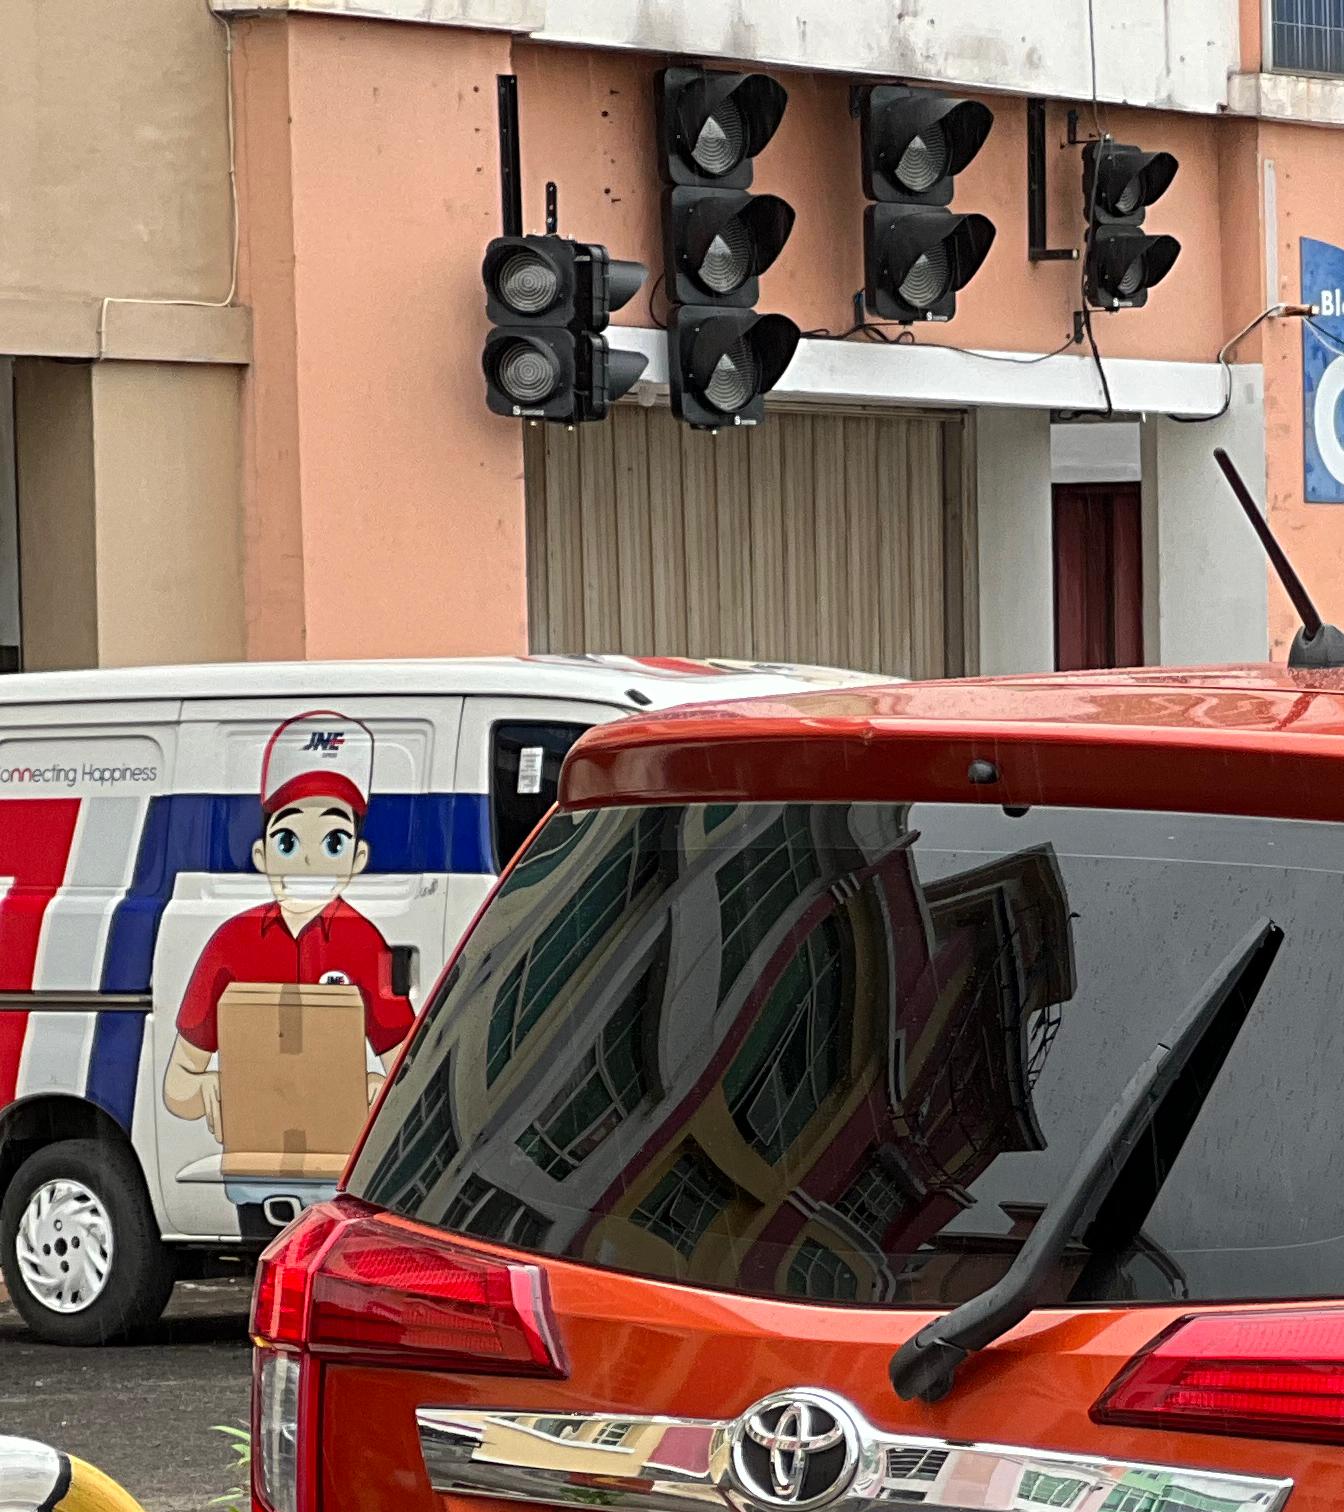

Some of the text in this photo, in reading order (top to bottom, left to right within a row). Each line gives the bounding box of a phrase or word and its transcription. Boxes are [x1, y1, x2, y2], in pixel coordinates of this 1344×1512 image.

[303, 732, 345, 750] JNE
[0, 762, 157, 787] onnecting Happiness
